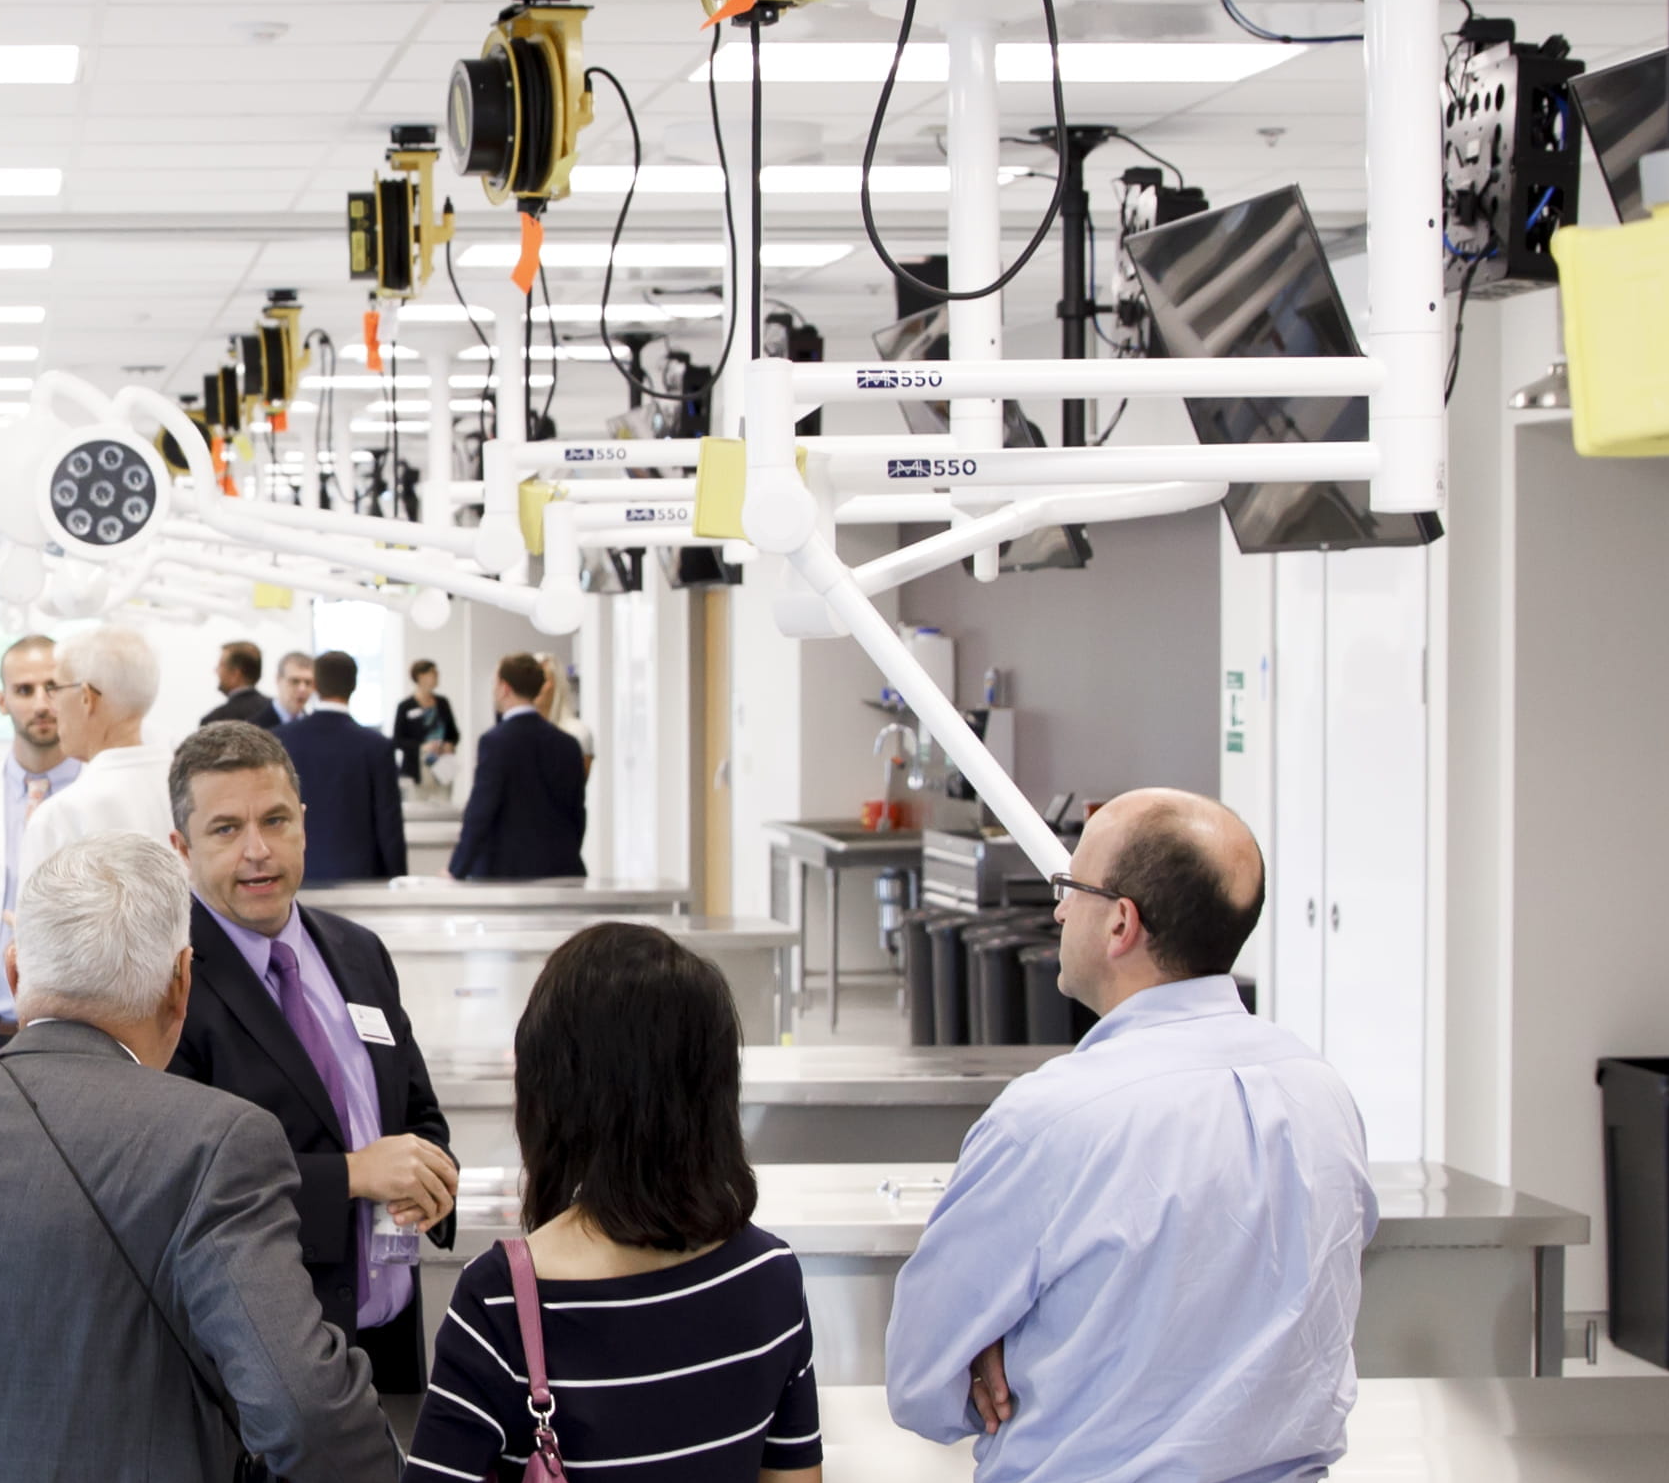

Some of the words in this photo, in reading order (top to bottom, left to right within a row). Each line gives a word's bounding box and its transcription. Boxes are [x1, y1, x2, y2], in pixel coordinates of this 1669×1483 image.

[901, 370, 943, 388] 550
[596, 449, 626, 460] 550
[933, 459, 977, 477] 550
[657, 508, 688, 520] 550
